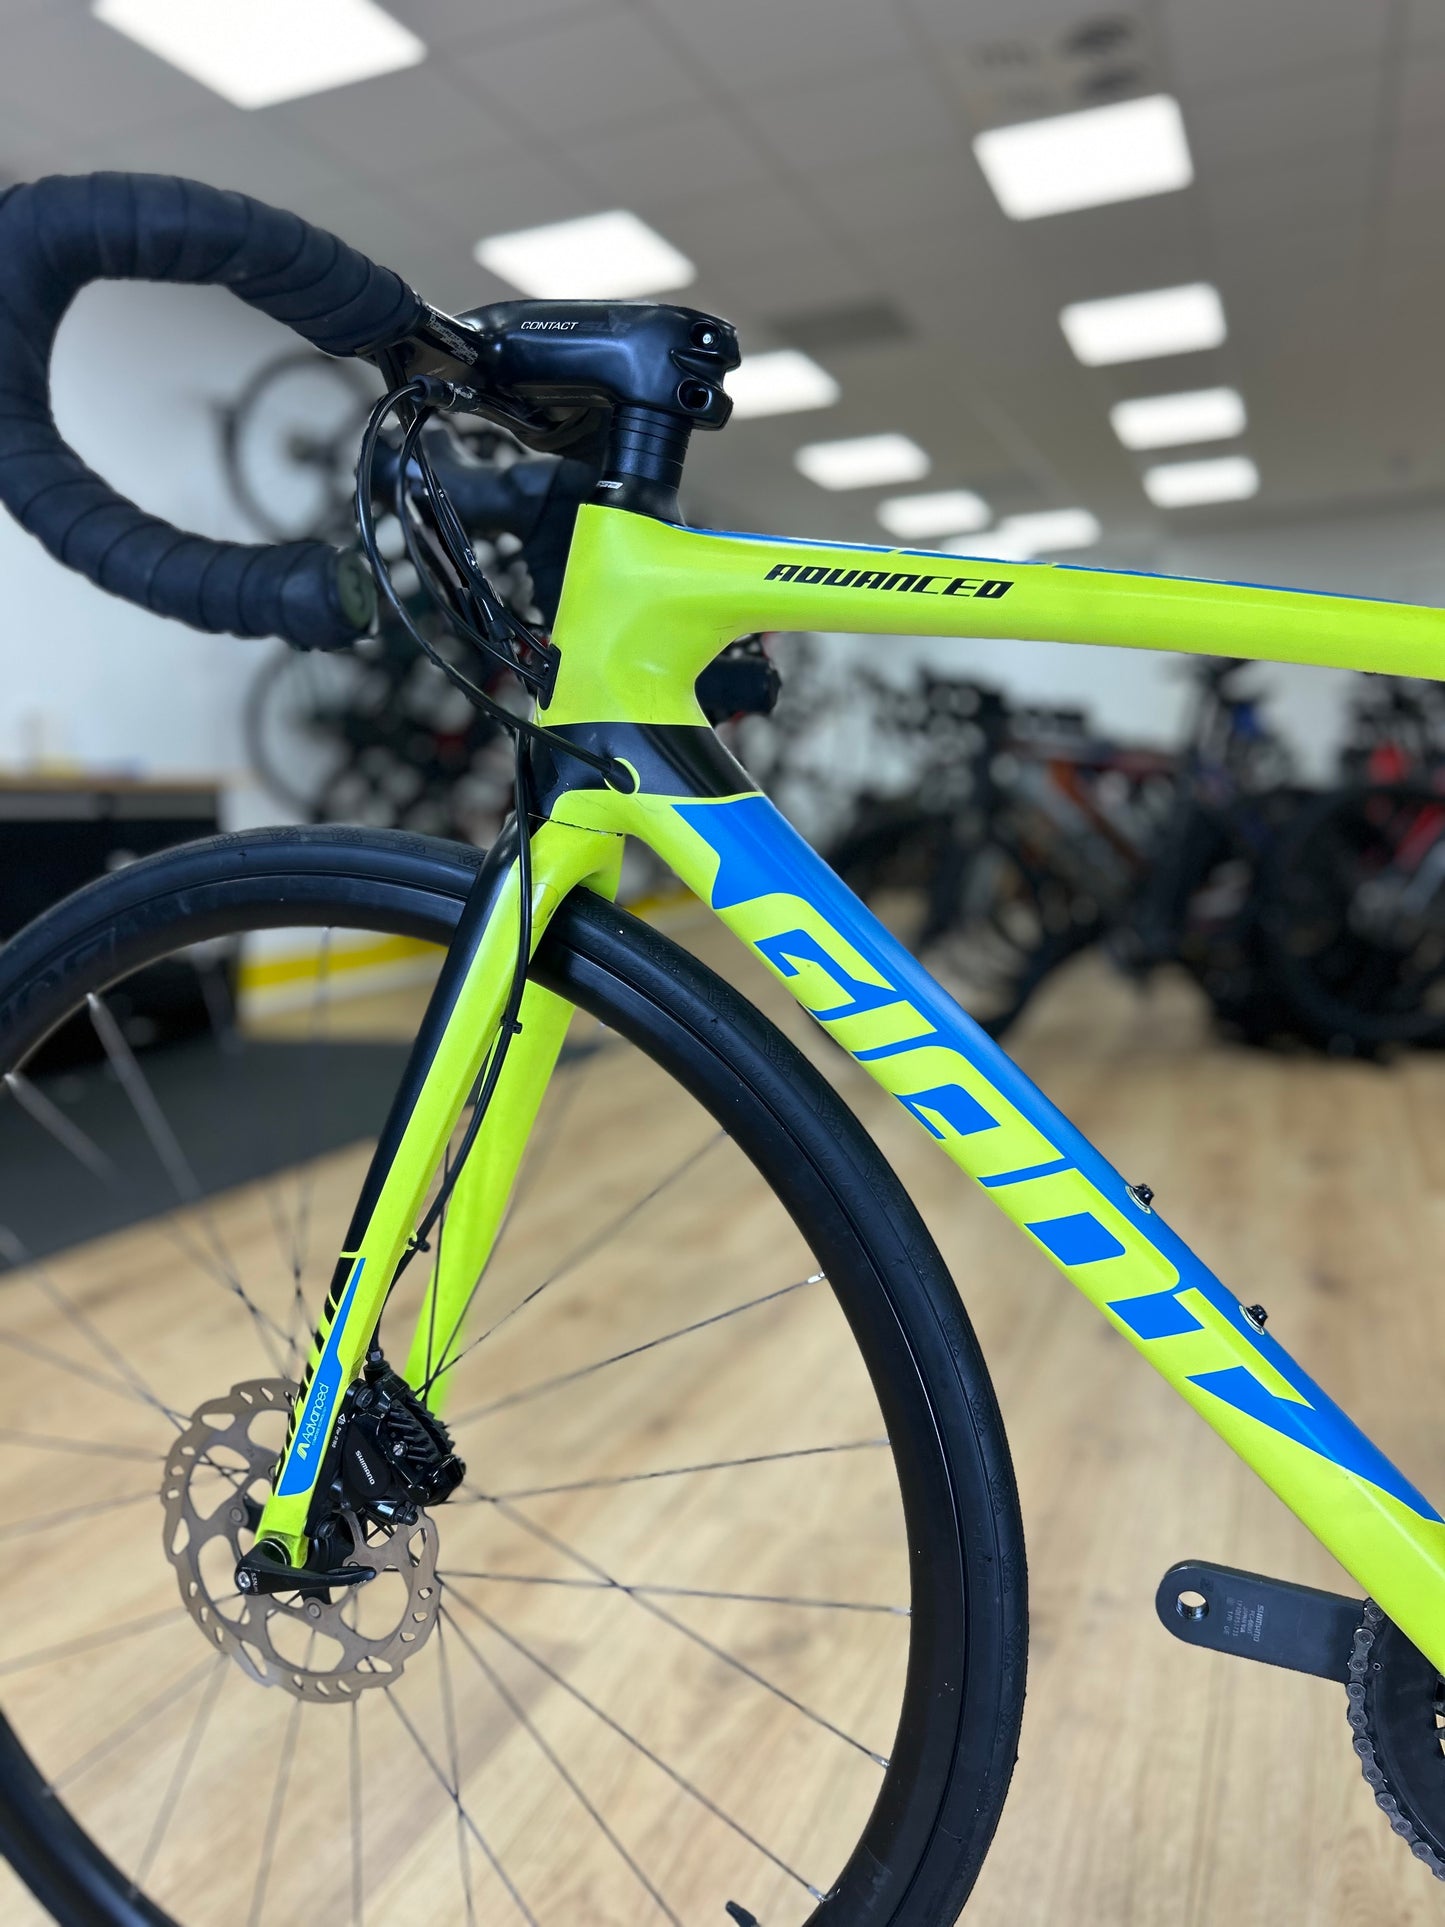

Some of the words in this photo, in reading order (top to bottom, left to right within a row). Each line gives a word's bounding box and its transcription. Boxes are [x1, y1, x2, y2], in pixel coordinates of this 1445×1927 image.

[520, 320, 579, 331] CONTACT
[763, 563, 1015, 599] ADVANCED
[303, 1382, 330, 1445] Advanced
[354, 1450, 376, 1486] SHIMANO
